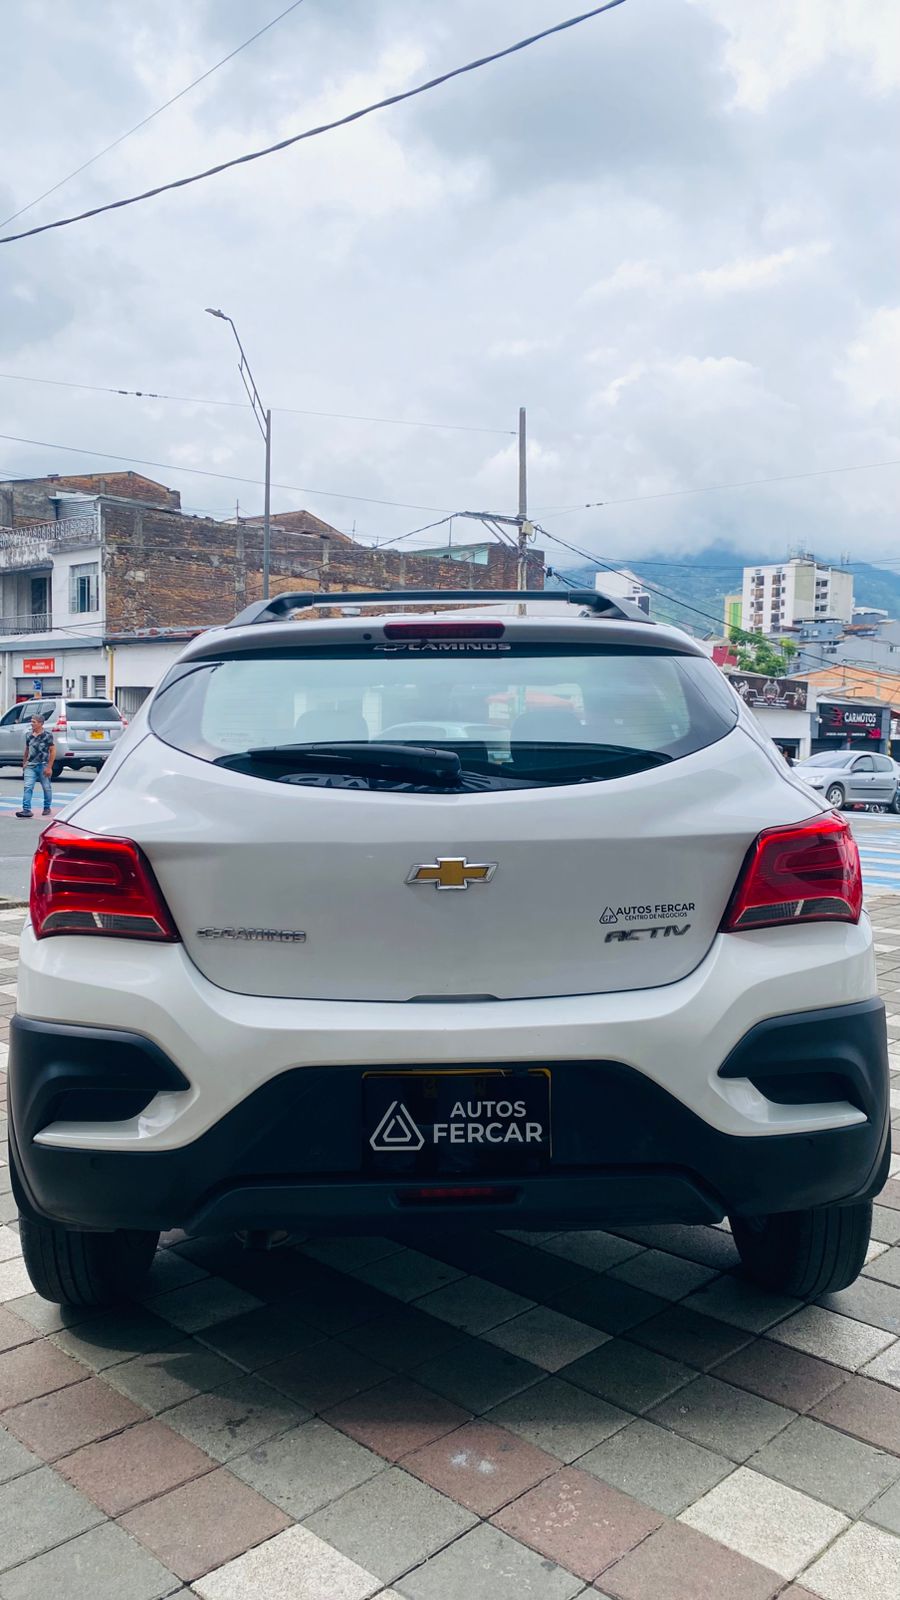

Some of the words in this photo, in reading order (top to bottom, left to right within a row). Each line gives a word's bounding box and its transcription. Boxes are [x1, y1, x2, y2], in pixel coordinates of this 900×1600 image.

[844, 712, 877, 723] CARMOTOS
[616, 905, 652, 915] AUTOS
[654, 902, 695, 913] FERCAR
[624, 913, 649, 921] CENTRO
[657, 911, 688, 919] NEGOCIOS
[604, 924, 691, 943] ACTIV
[450, 1101, 527, 1118] AUTOS
[433, 1122, 543, 1144] FERCAR
